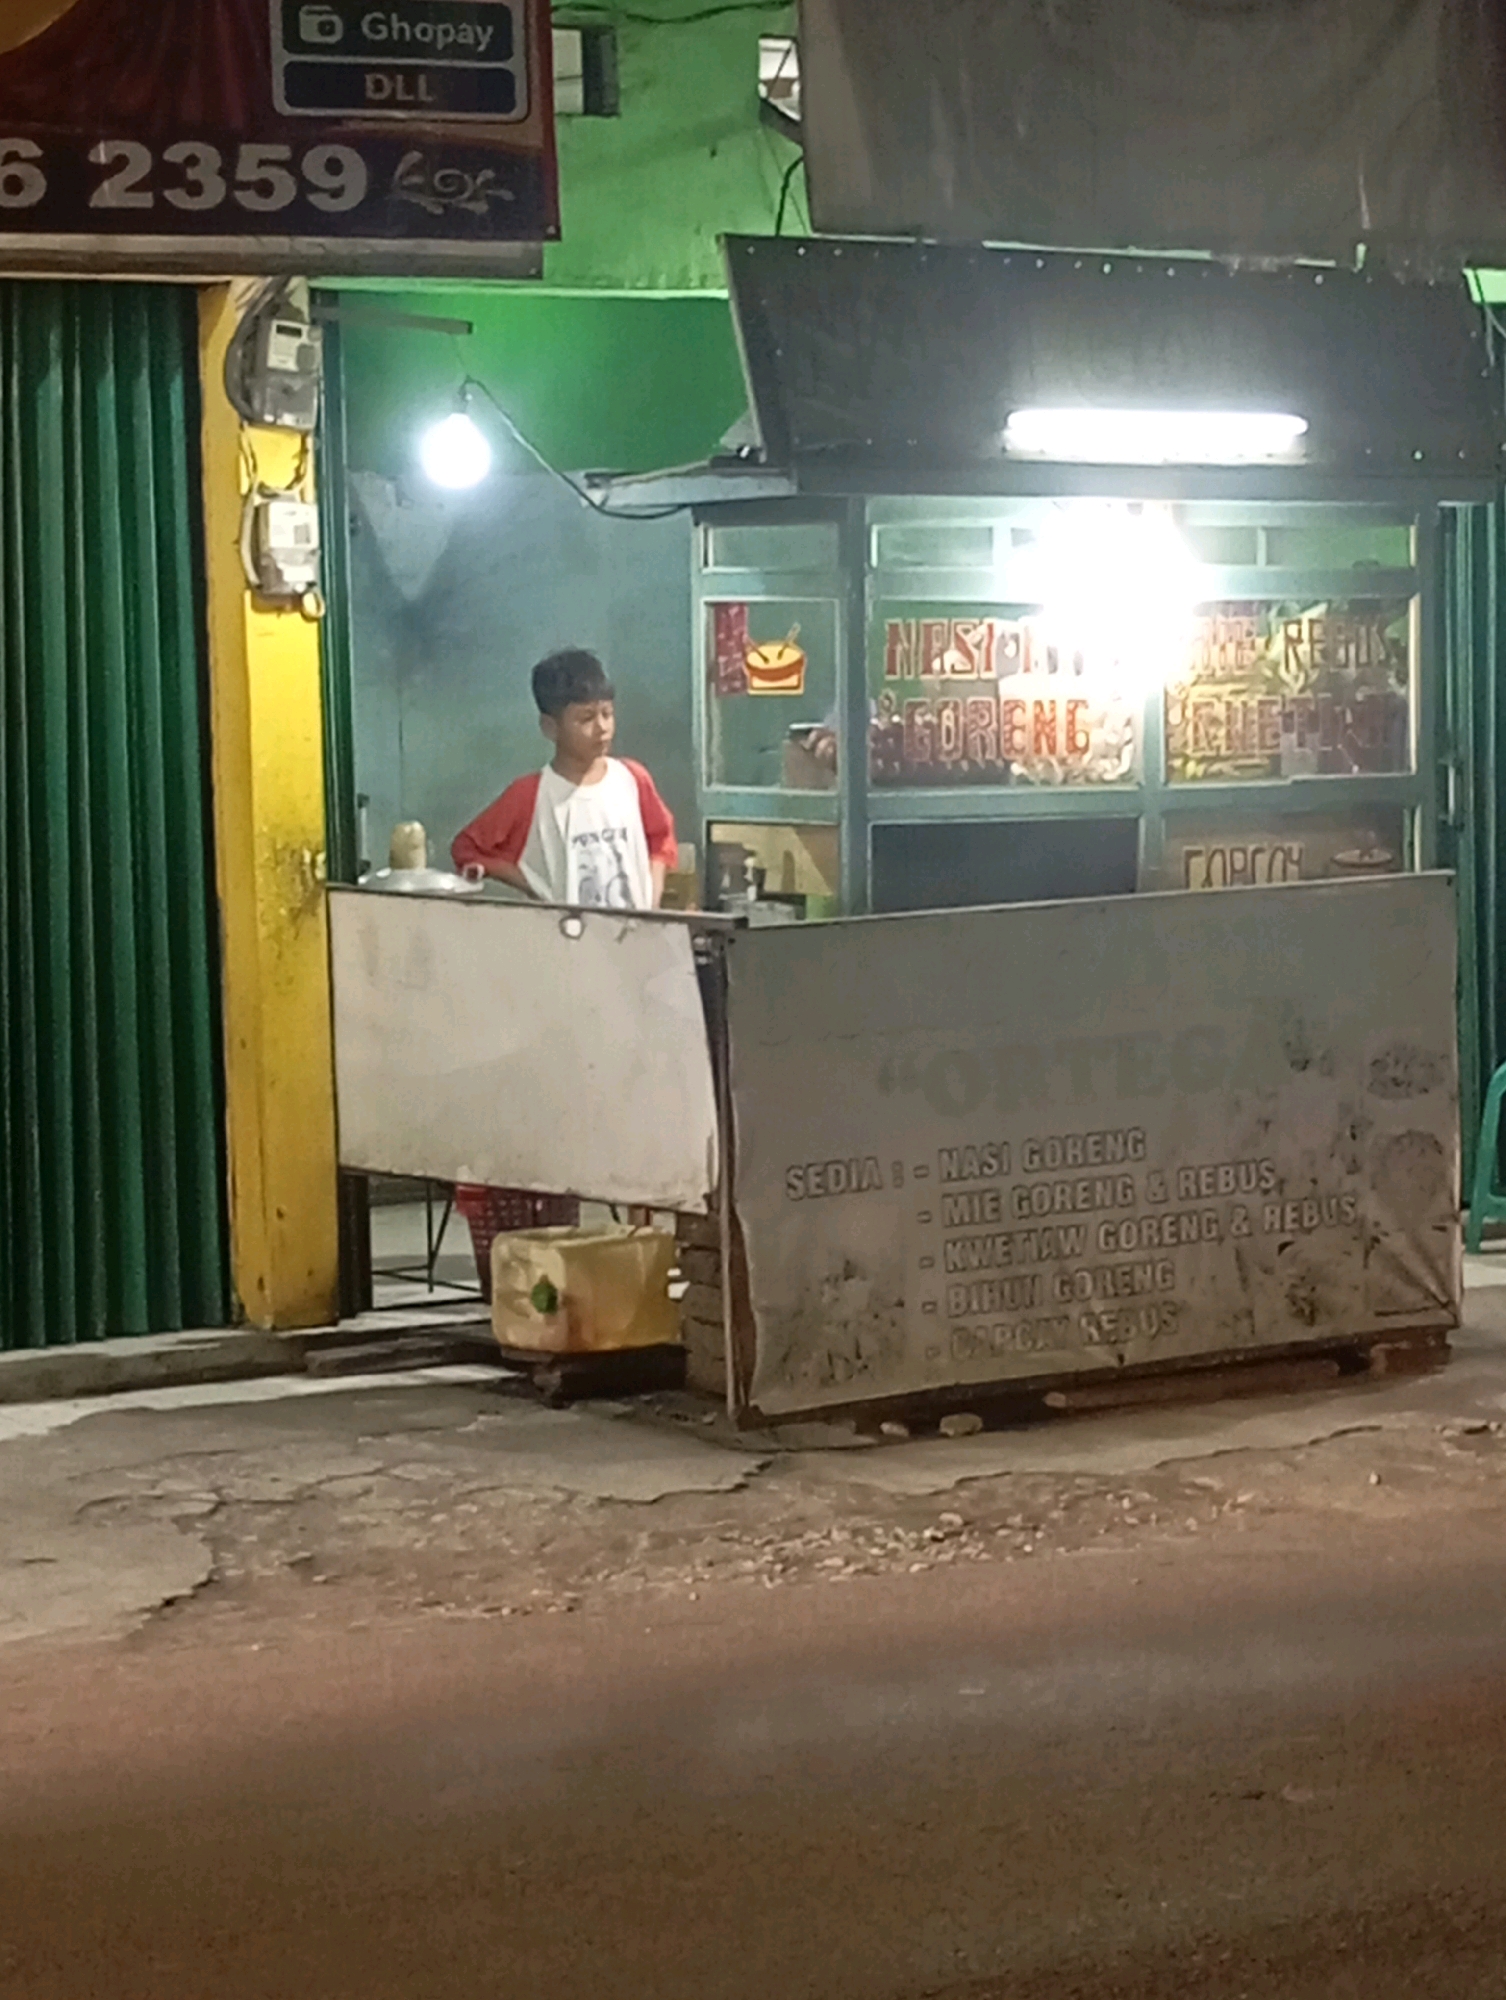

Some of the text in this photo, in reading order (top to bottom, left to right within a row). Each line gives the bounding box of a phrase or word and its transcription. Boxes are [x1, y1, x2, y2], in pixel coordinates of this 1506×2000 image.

[364, 73, 436, 101] DLL
[88, 139, 367, 212] 2359
[785, 1156, 883, 1200] SEDIA
[938, 1142, 1011, 1183] NASI
[1021, 1127, 1146, 1173] GORENG
[942, 1189, 1001, 1228] MIE
[1011, 1174, 1135, 1220] GORENG
[1177, 1157, 1278, 1201] REBUS
[1098, 1210, 1221, 1252] GORENG
[1263, 1196, 1357, 1235] REBUS
[1053, 1257, 1176, 1304] GORENG
